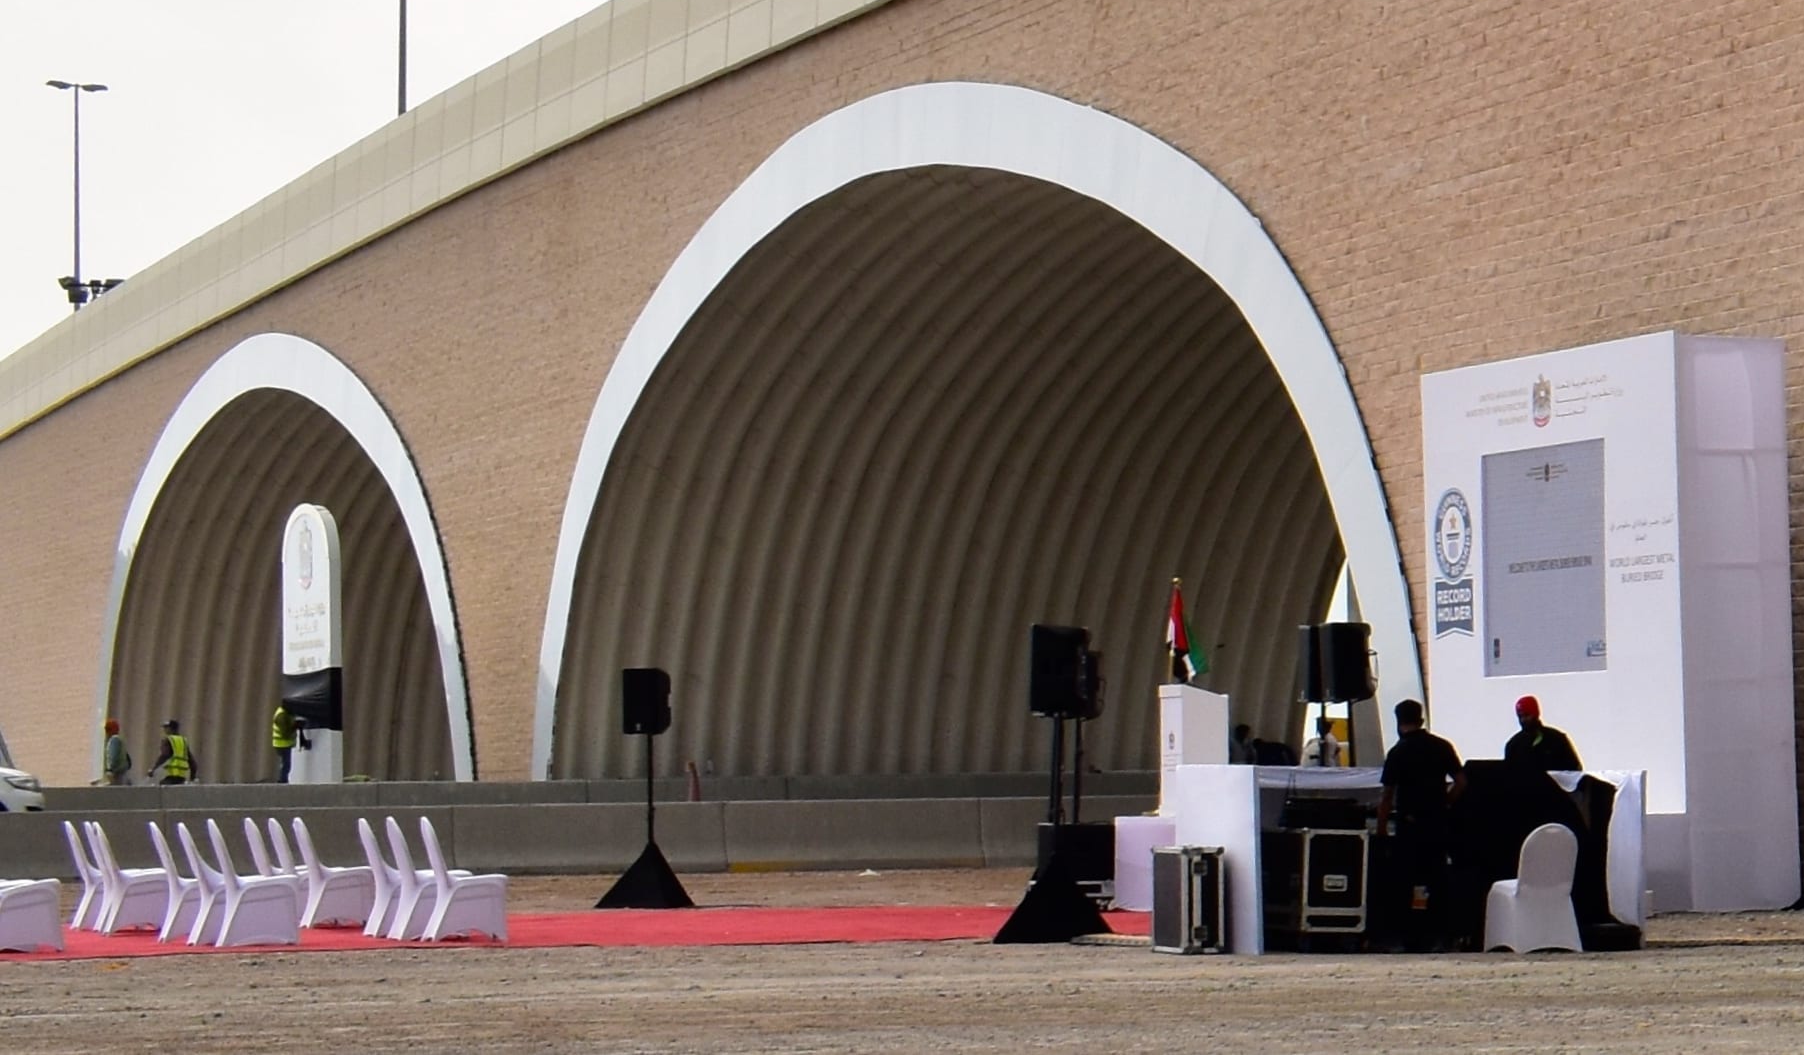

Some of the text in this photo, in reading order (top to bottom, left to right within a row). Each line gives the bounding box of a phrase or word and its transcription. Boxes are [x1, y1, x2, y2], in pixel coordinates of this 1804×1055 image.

[1631, 554, 1656, 566] LARGEST
[1643, 569, 1664, 581] BRIDGE
[1437, 588, 1471, 605] RECORD
[1437, 605, 1472, 622] HOLDER
